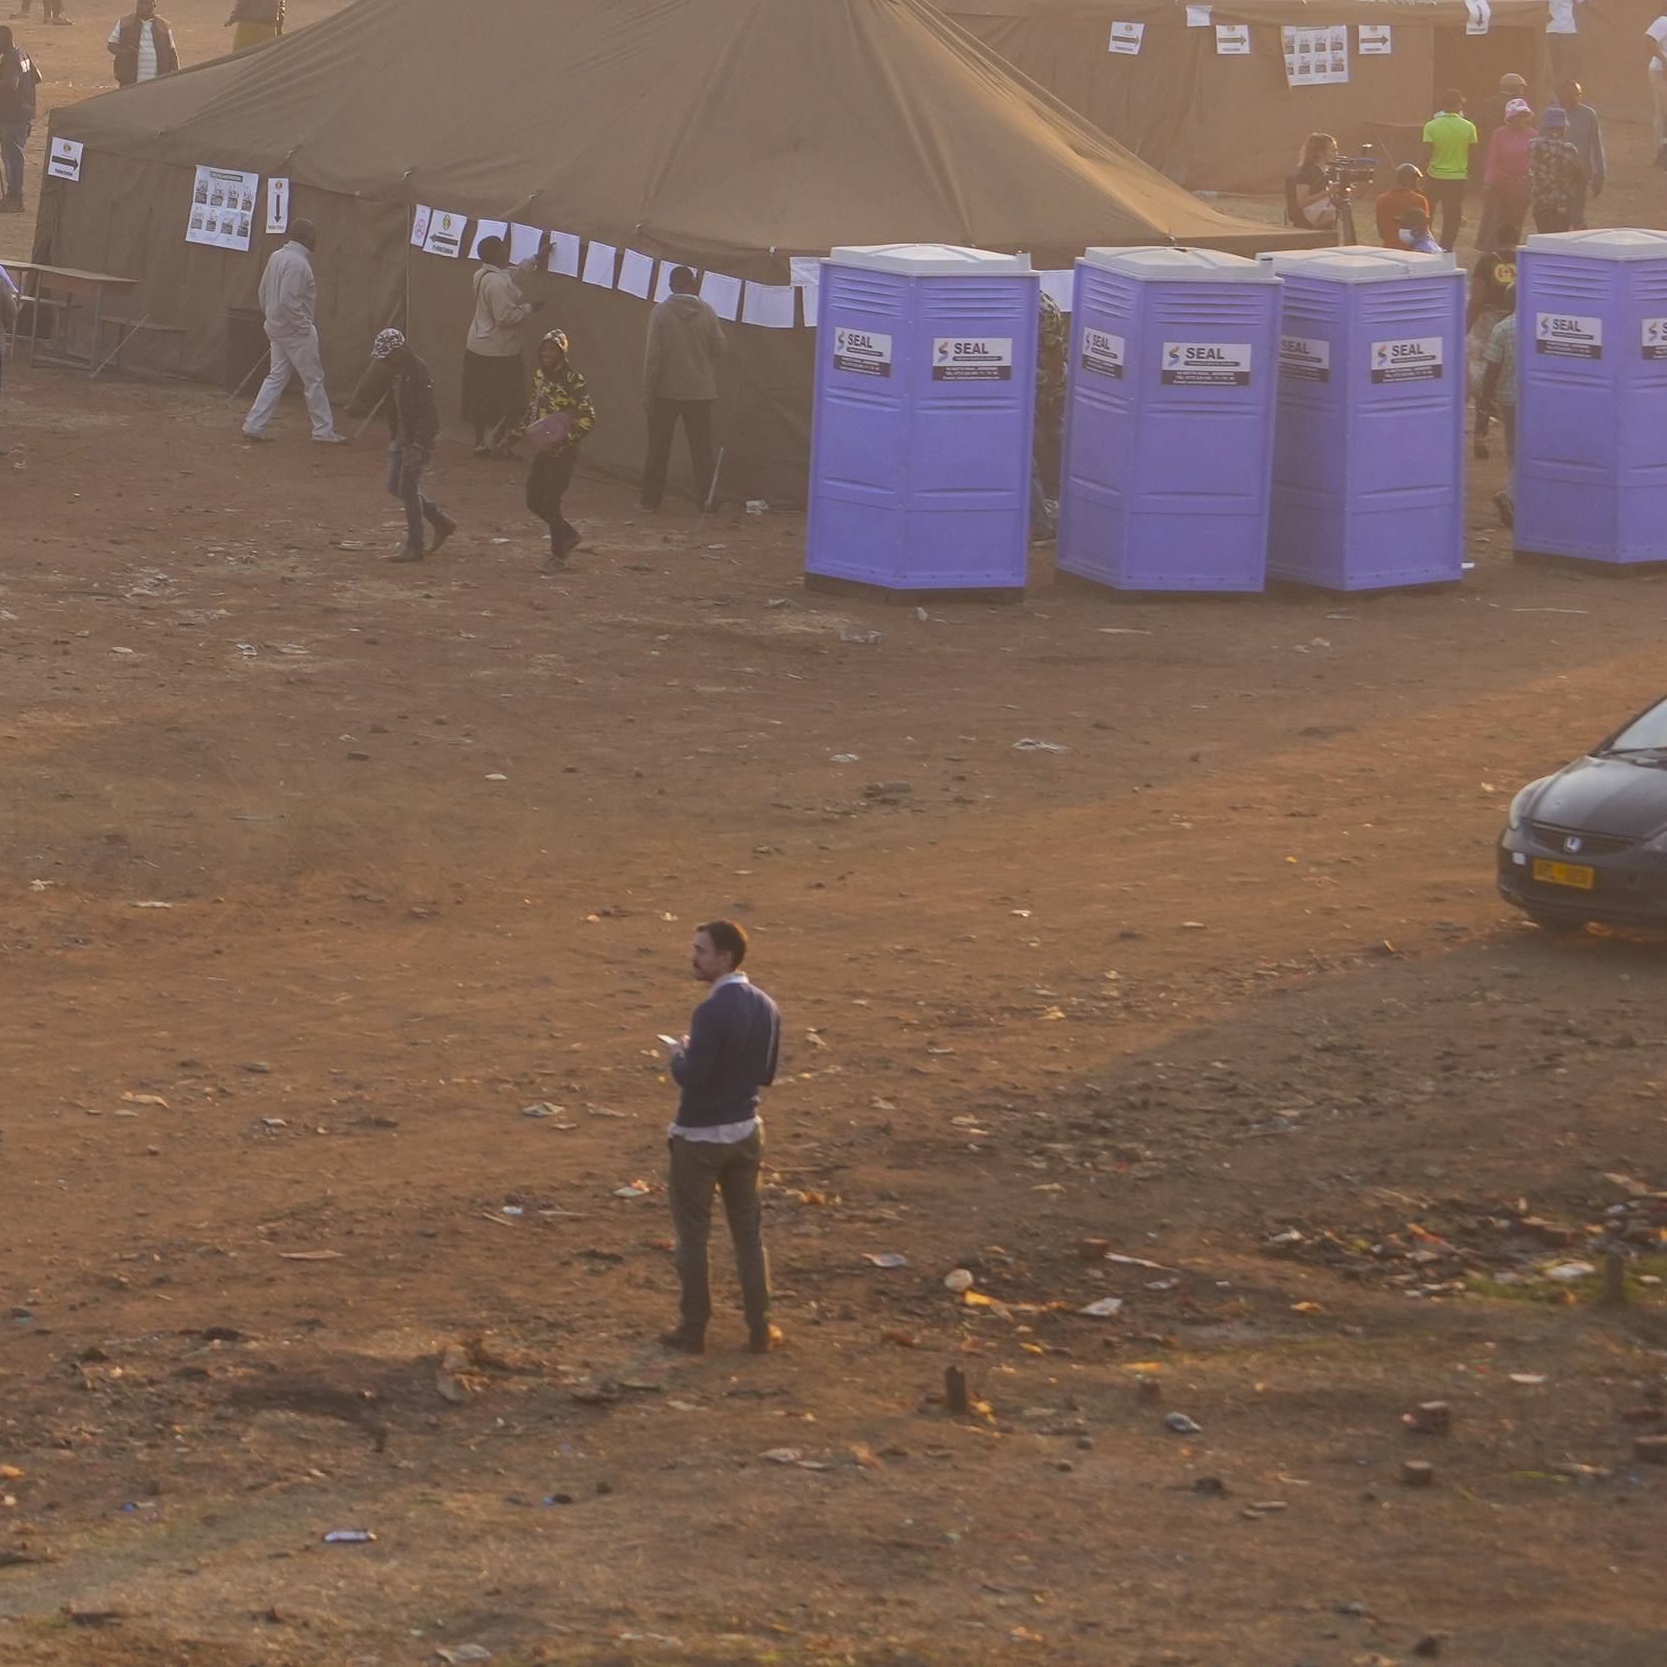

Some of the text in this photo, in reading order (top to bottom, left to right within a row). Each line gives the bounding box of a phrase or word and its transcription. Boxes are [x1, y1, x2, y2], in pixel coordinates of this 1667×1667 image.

[1552, 318, 1582, 332] SEAL
[847, 333, 873, 348] SEAL
[1091, 334, 1110, 350] SEAL
[1280, 339, 1310, 354] SEAL
[953, 342, 989, 355] SEAL
[1186, 347, 1225, 360] SEAL
[1391, 343, 1423, 356] SEAL
